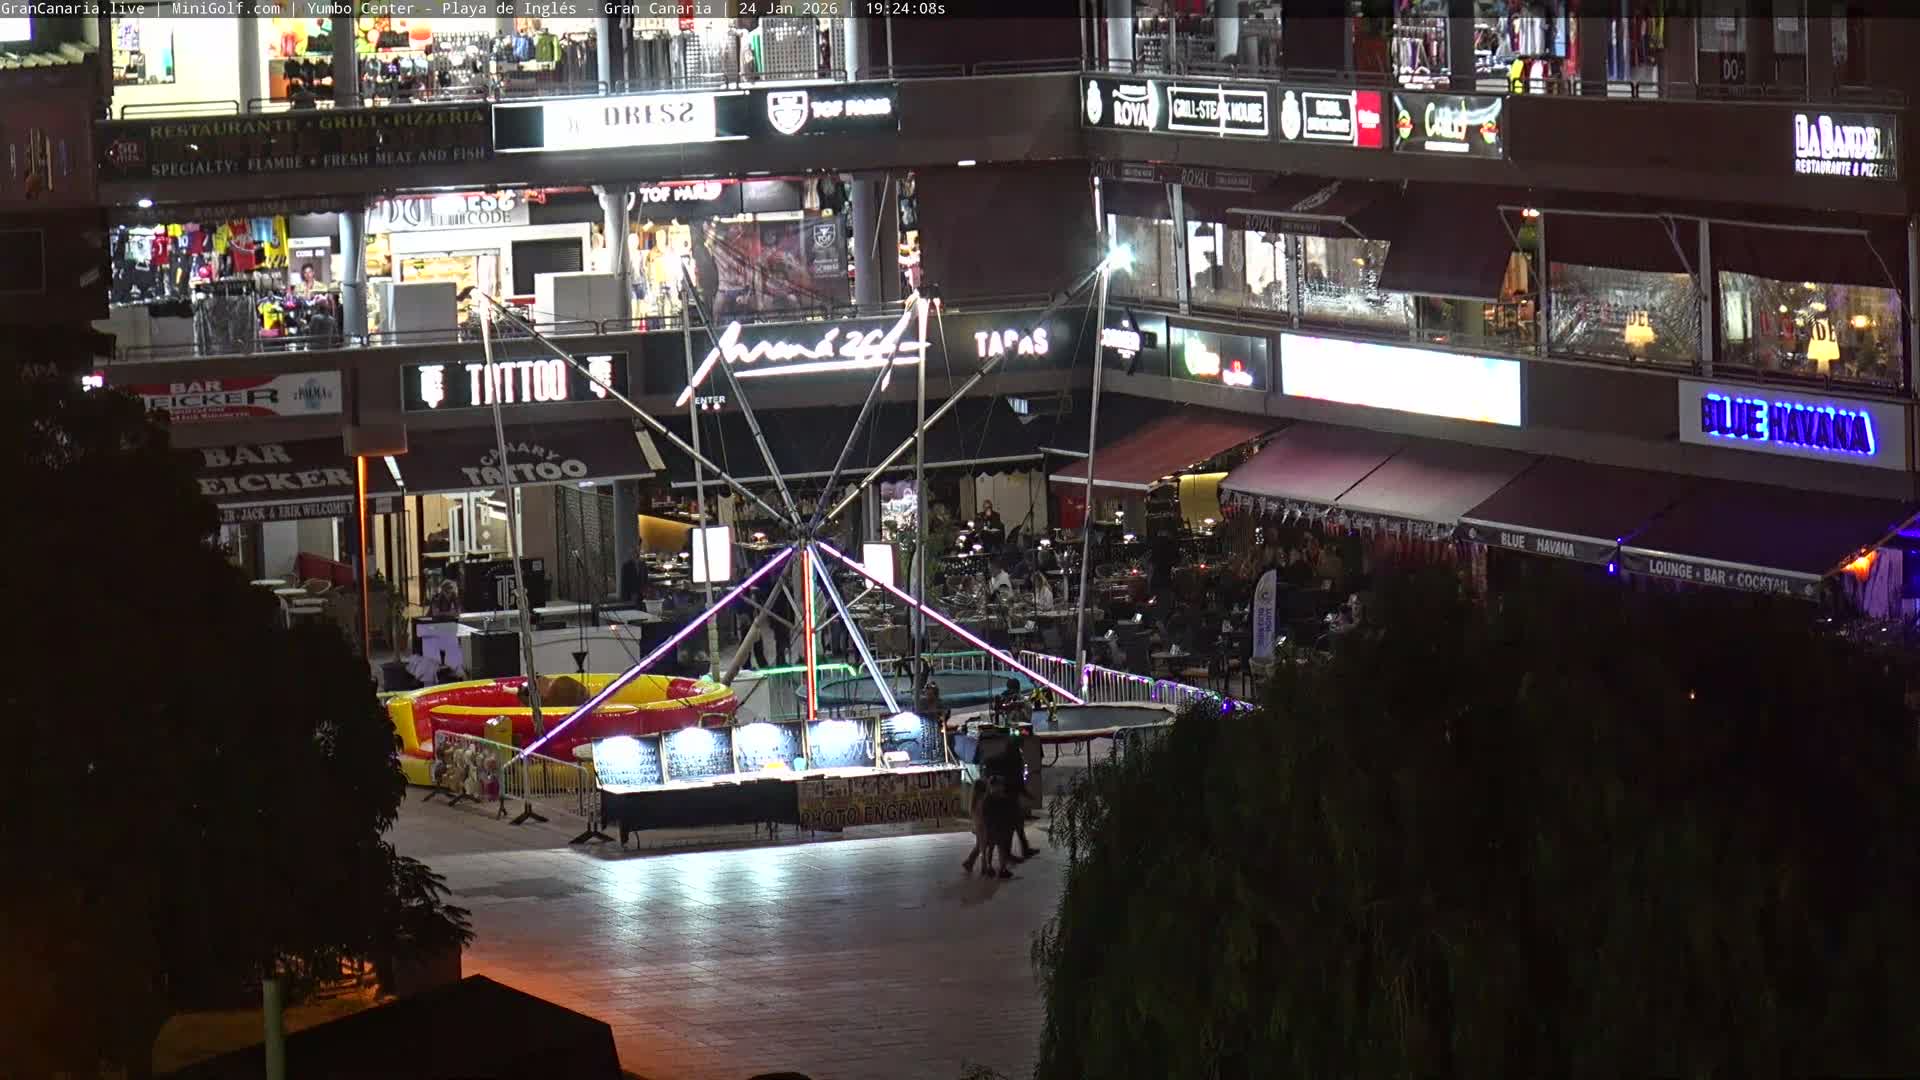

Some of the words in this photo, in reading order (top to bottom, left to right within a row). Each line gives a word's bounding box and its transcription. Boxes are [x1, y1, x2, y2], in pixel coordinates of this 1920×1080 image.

[150, 119, 297, 138] RESTAURANTE
[393, 111, 484, 126] PIZZERIA
[323, 152, 368, 168] FRESH
[376, 151, 413, 165] MEAT
[418, 149, 447, 162] AND
[453, 147, 485, 161] FISH
[1796, 159, 1850, 175] RESTAURANTE
[464, 210, 512, 224] CODE
[974, 327, 1049, 358] TAPAS
[169, 380, 223, 394] BAR
[465, 359, 567, 406] TATTOO
[694, 396, 725, 405] ENTER
[1701, 394, 1769, 441] BLUE
[1769, 402, 1876, 455] HAVANA
[200, 443, 293, 468] BAR
[480, 442, 561, 467] CANARY
[195, 468, 353, 496] EICKER
[461, 458, 588, 486] TATTOO
[302, 502, 346, 517] WELCOME
[1501, 531, 1526, 549] BLUE
[1536, 538, 1576, 558] HAVANA
[1649, 559, 1692, 579] LOUNGE
[1704, 569, 1726, 585] BAR
[1737, 573, 1791, 594] COCKTAIL
[801, 806, 857, 826] PHOTO
